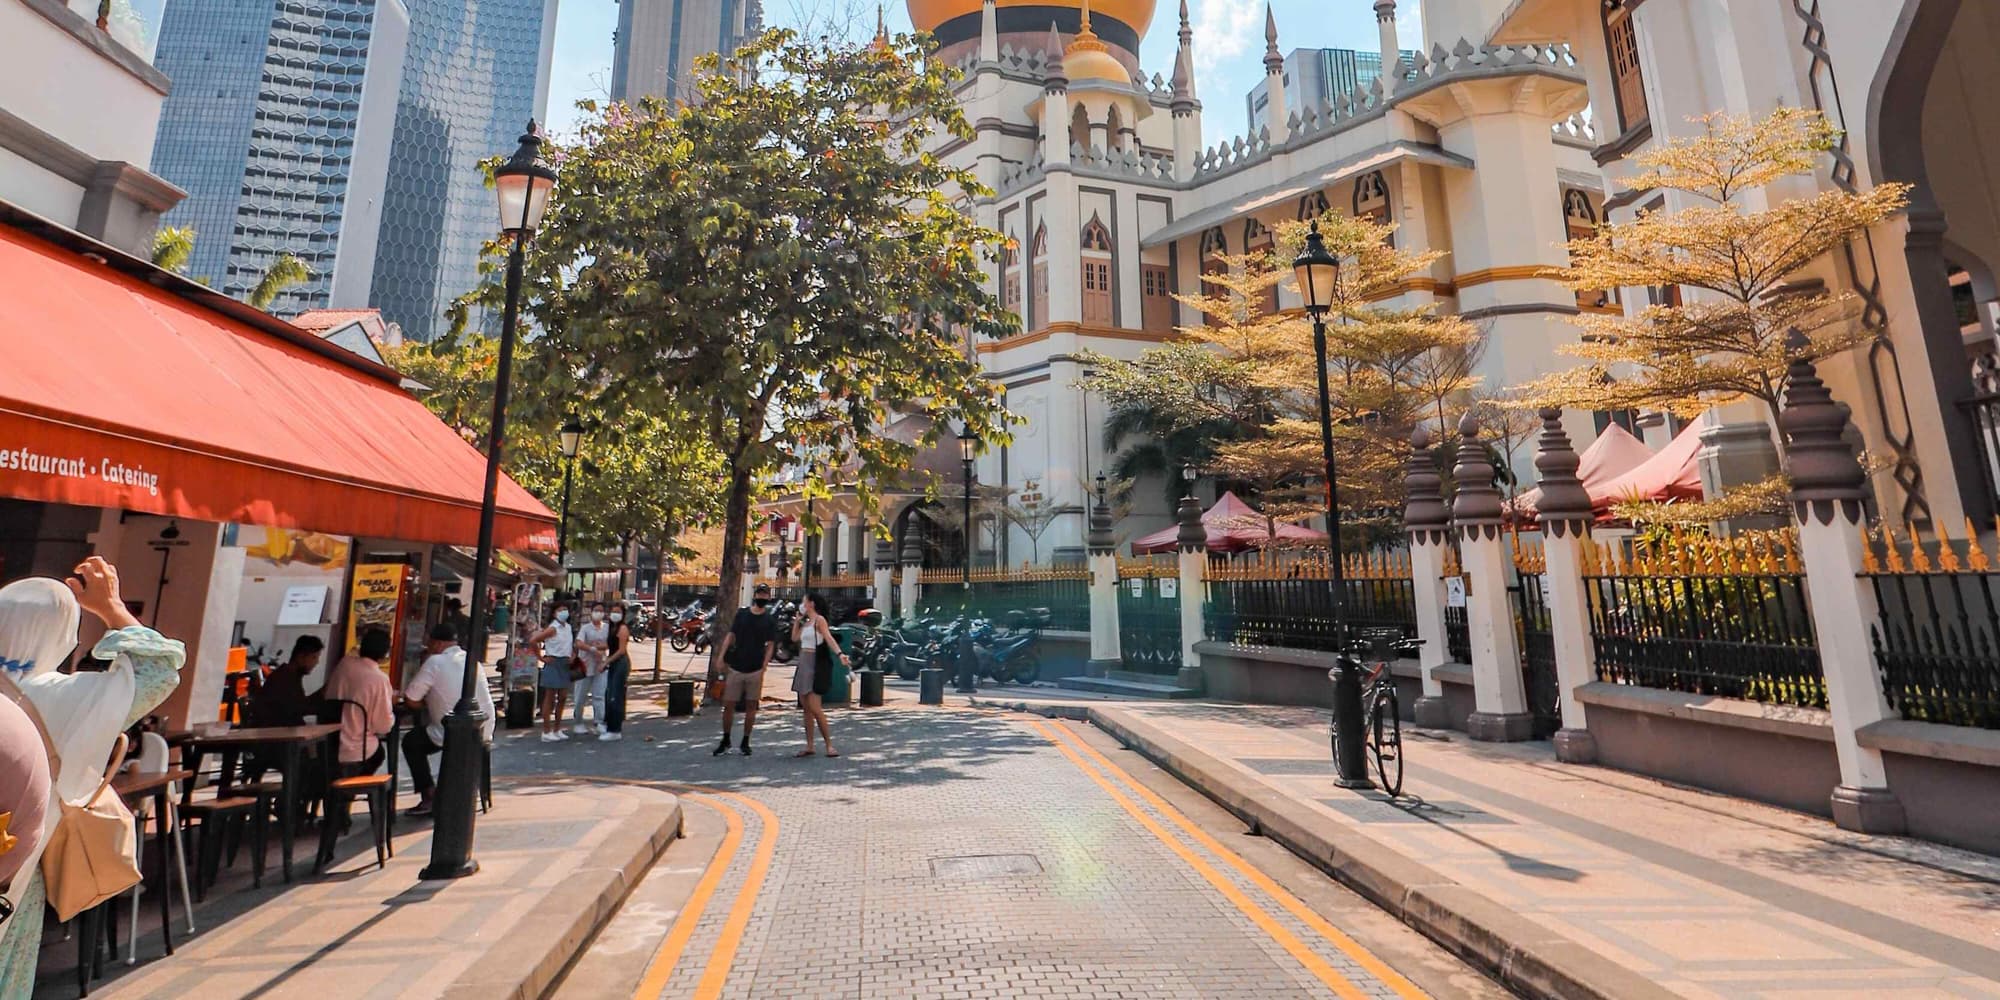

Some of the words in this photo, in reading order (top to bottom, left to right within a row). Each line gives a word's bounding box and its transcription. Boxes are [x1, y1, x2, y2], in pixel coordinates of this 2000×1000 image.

[0, 447, 86, 479] estaurant
[101, 457, 159, 497] Catering
[358, 579, 393, 588] PISANG
